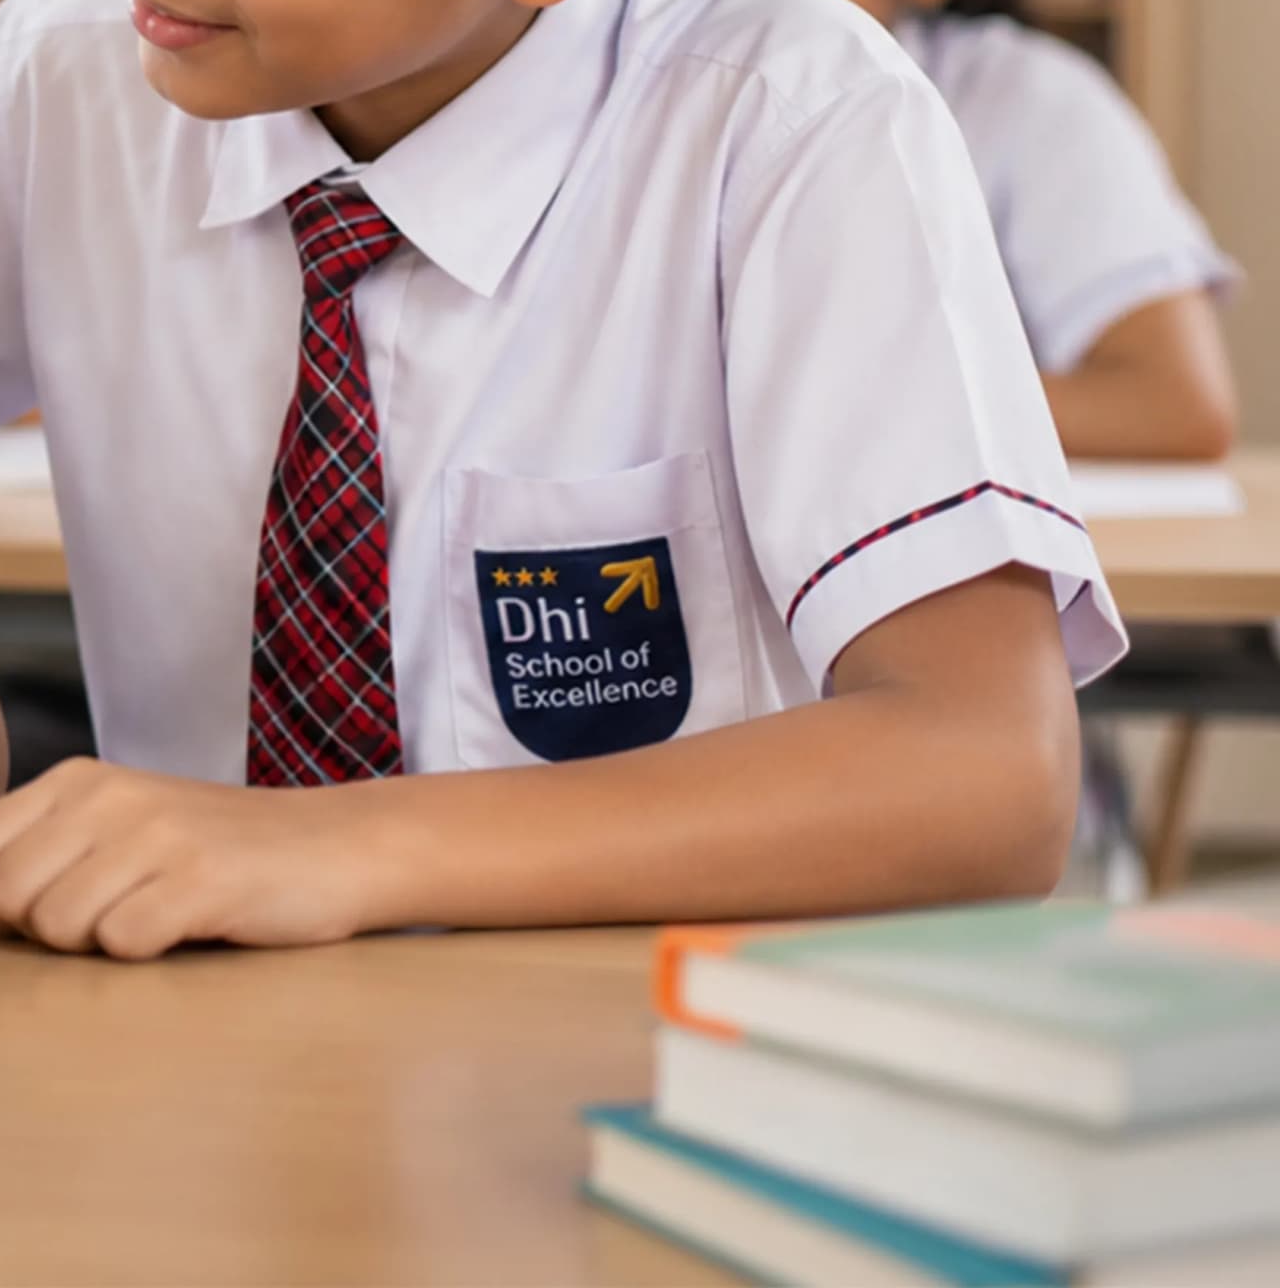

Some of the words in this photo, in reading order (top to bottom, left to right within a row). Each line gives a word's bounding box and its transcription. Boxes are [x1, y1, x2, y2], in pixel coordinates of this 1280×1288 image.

[496, 597, 590, 643] Dhi
[506, 648, 613, 679] School
[620, 641, 651, 670] of
[512, 676, 678, 709] Excellence
